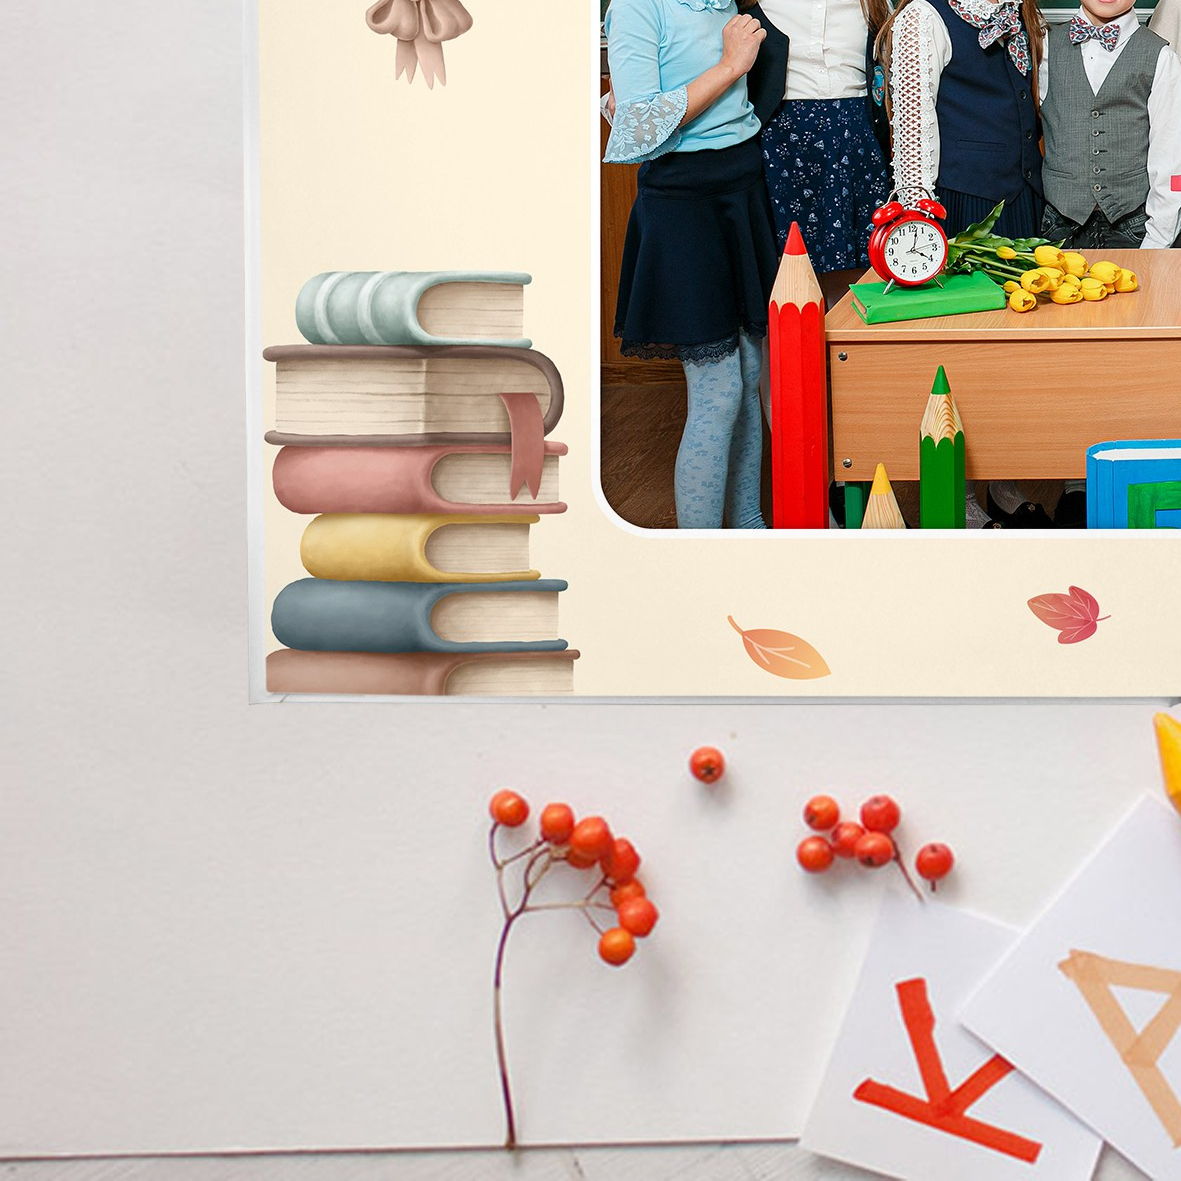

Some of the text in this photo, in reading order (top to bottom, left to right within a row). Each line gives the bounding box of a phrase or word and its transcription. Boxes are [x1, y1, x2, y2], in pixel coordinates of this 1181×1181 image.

[928, 233, 934, 241] 2
[931, 243, 938, 251] 3
[888, 247, 894, 256] 9
[892, 258, 899, 266] 8
[911, 266, 917, 274] 6
[852, 976, 1043, 1165] К
